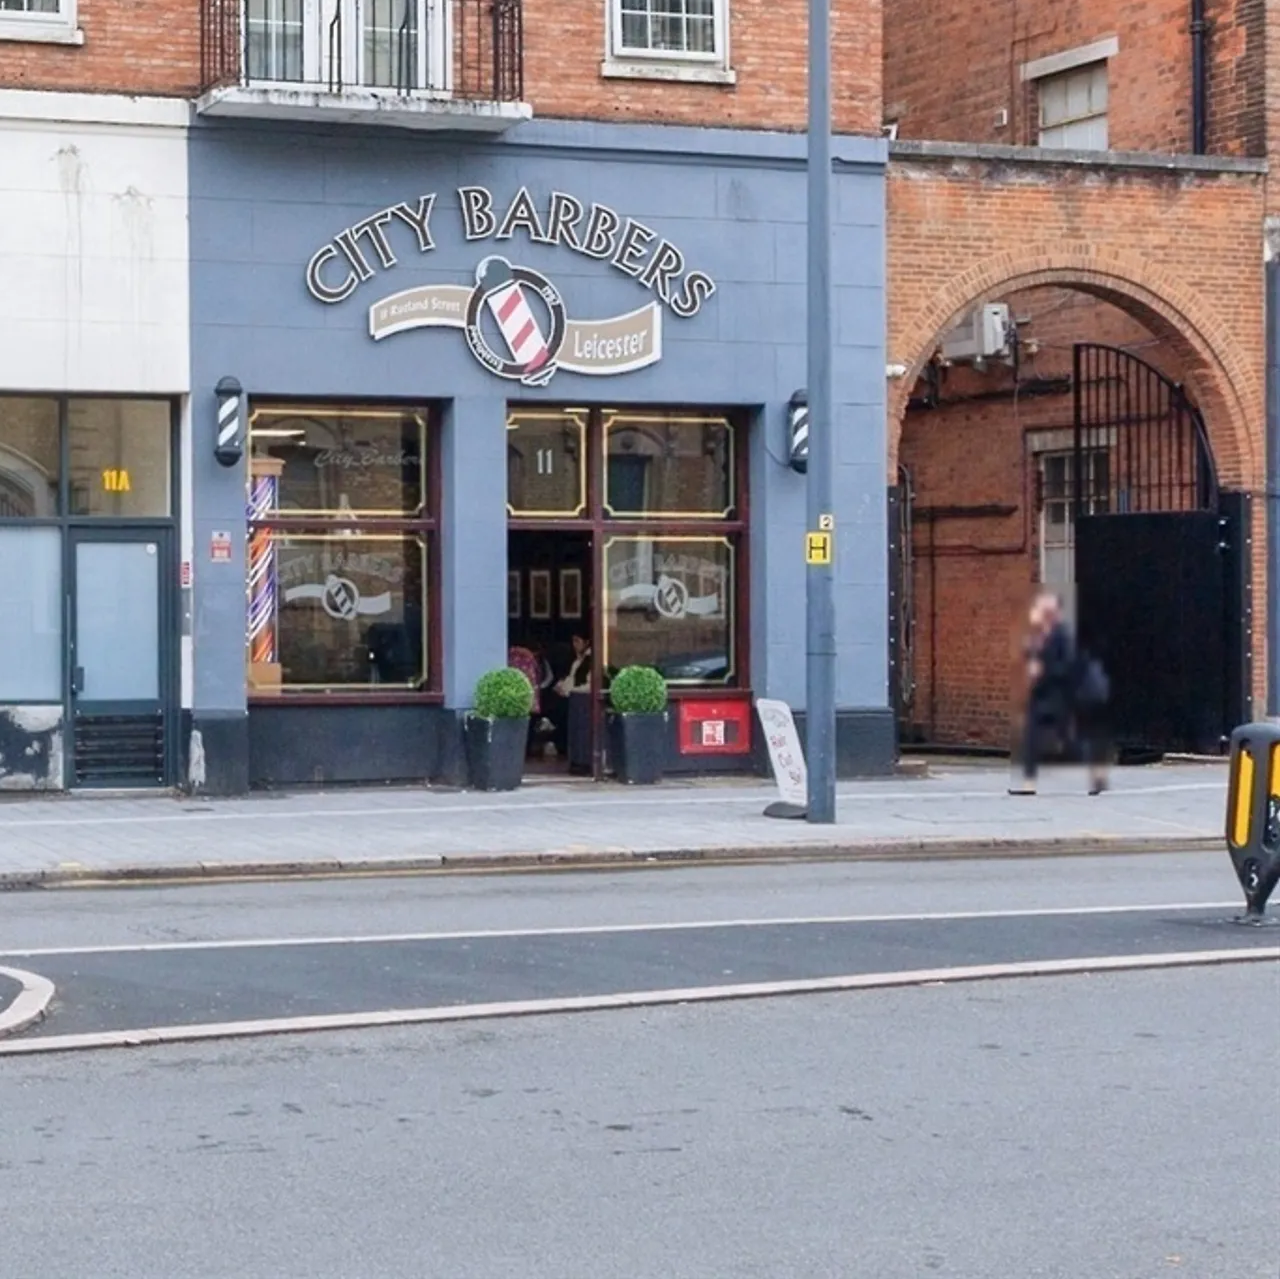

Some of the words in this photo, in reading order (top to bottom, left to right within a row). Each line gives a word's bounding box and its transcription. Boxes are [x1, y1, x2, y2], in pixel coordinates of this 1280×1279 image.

[305, 192, 438, 303] CITY
[456, 184, 717, 318] BARBERS
[573, 325, 649, 361] Leicester
[536, 448, 554, 474] 11
[102, 468, 131, 492] 11A
[808, 536, 828, 560] H
